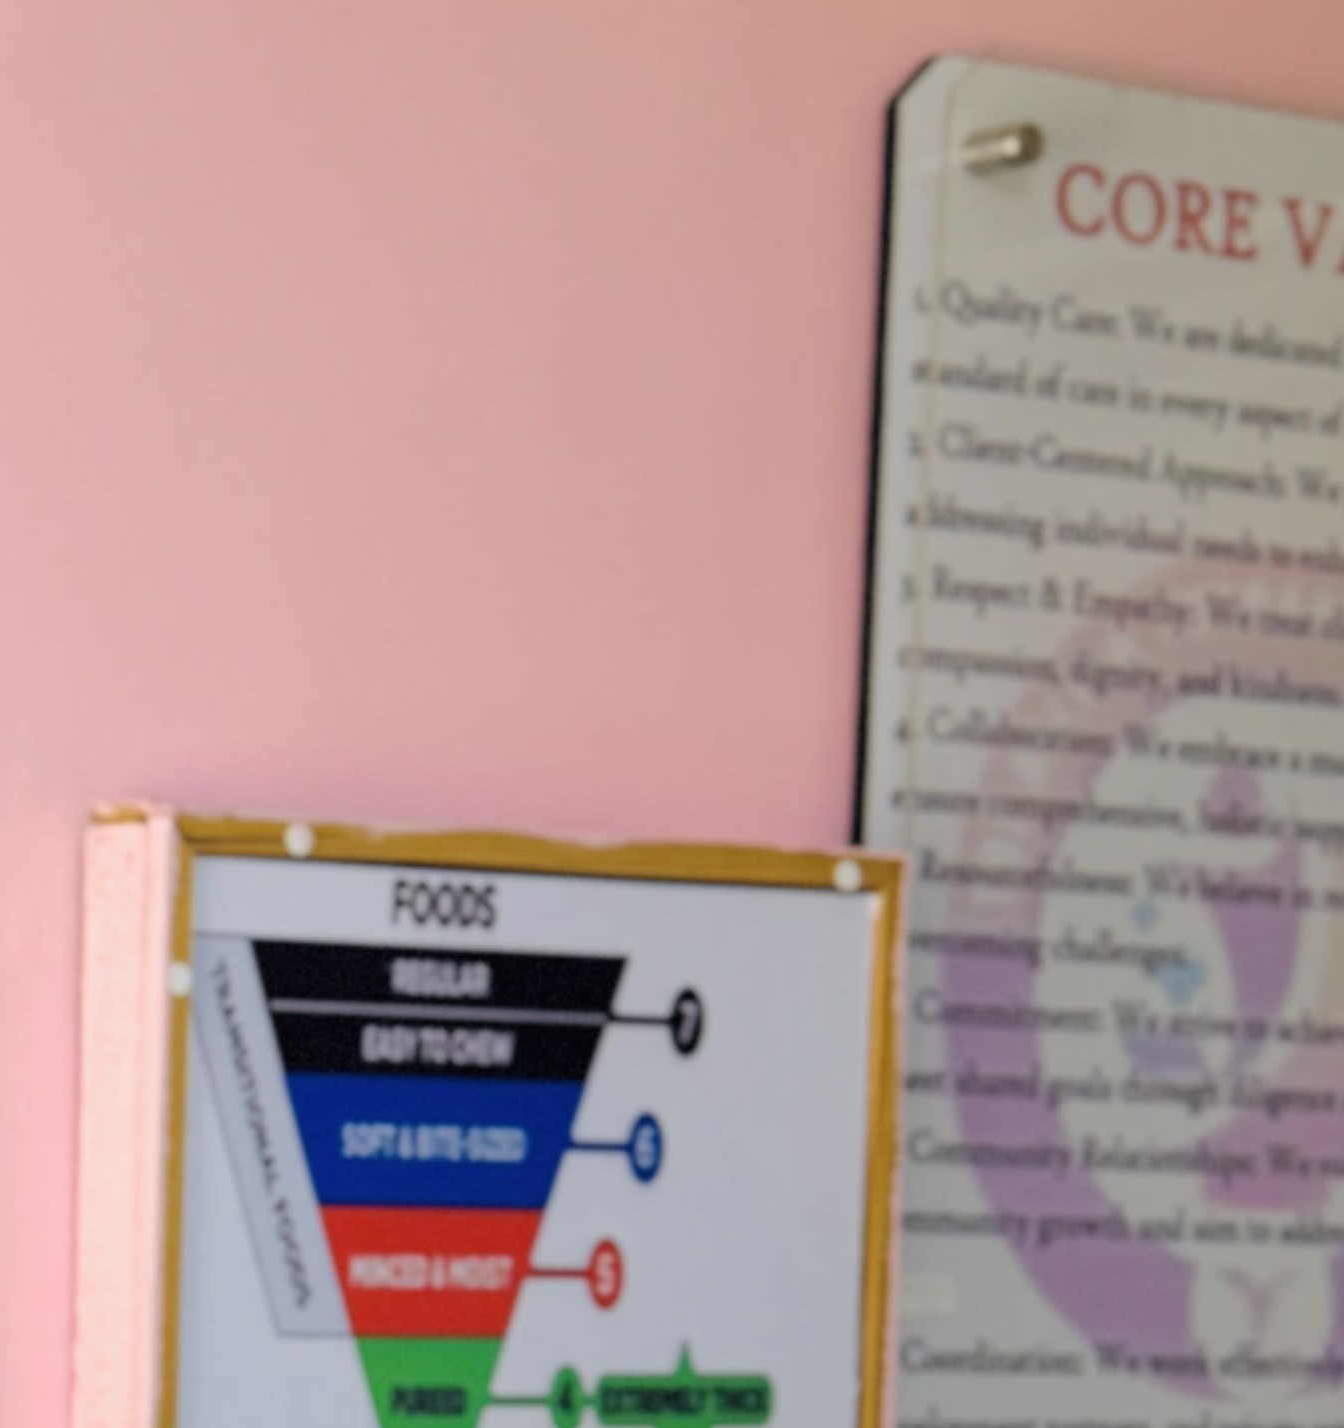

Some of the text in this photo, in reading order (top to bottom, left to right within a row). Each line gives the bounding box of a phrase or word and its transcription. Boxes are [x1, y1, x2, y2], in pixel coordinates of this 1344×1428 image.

[1054, 161, 1259, 262] CORE
[389, 879, 498, 930] FOODS
[390, 957, 493, 999] REGULAR
[678, 1001, 695, 1044] 7
[360, 1025, 517, 1067] EASY TO CHEW
[340, 1122, 395, 1158] SOFT
[417, 1124, 528, 1163] BITE-SIZED
[636, 1124, 656, 1171] 6
[348, 1253, 426, 1289] MINCED
[450, 1255, 514, 1292] MOIST
[596, 1249, 615, 1297] 5
[389, 1384, 469, 1417] PUREED
[558, 1384, 573, 1413] 4
[600, 1384, 769, 1418] EXTREMELY THICK
